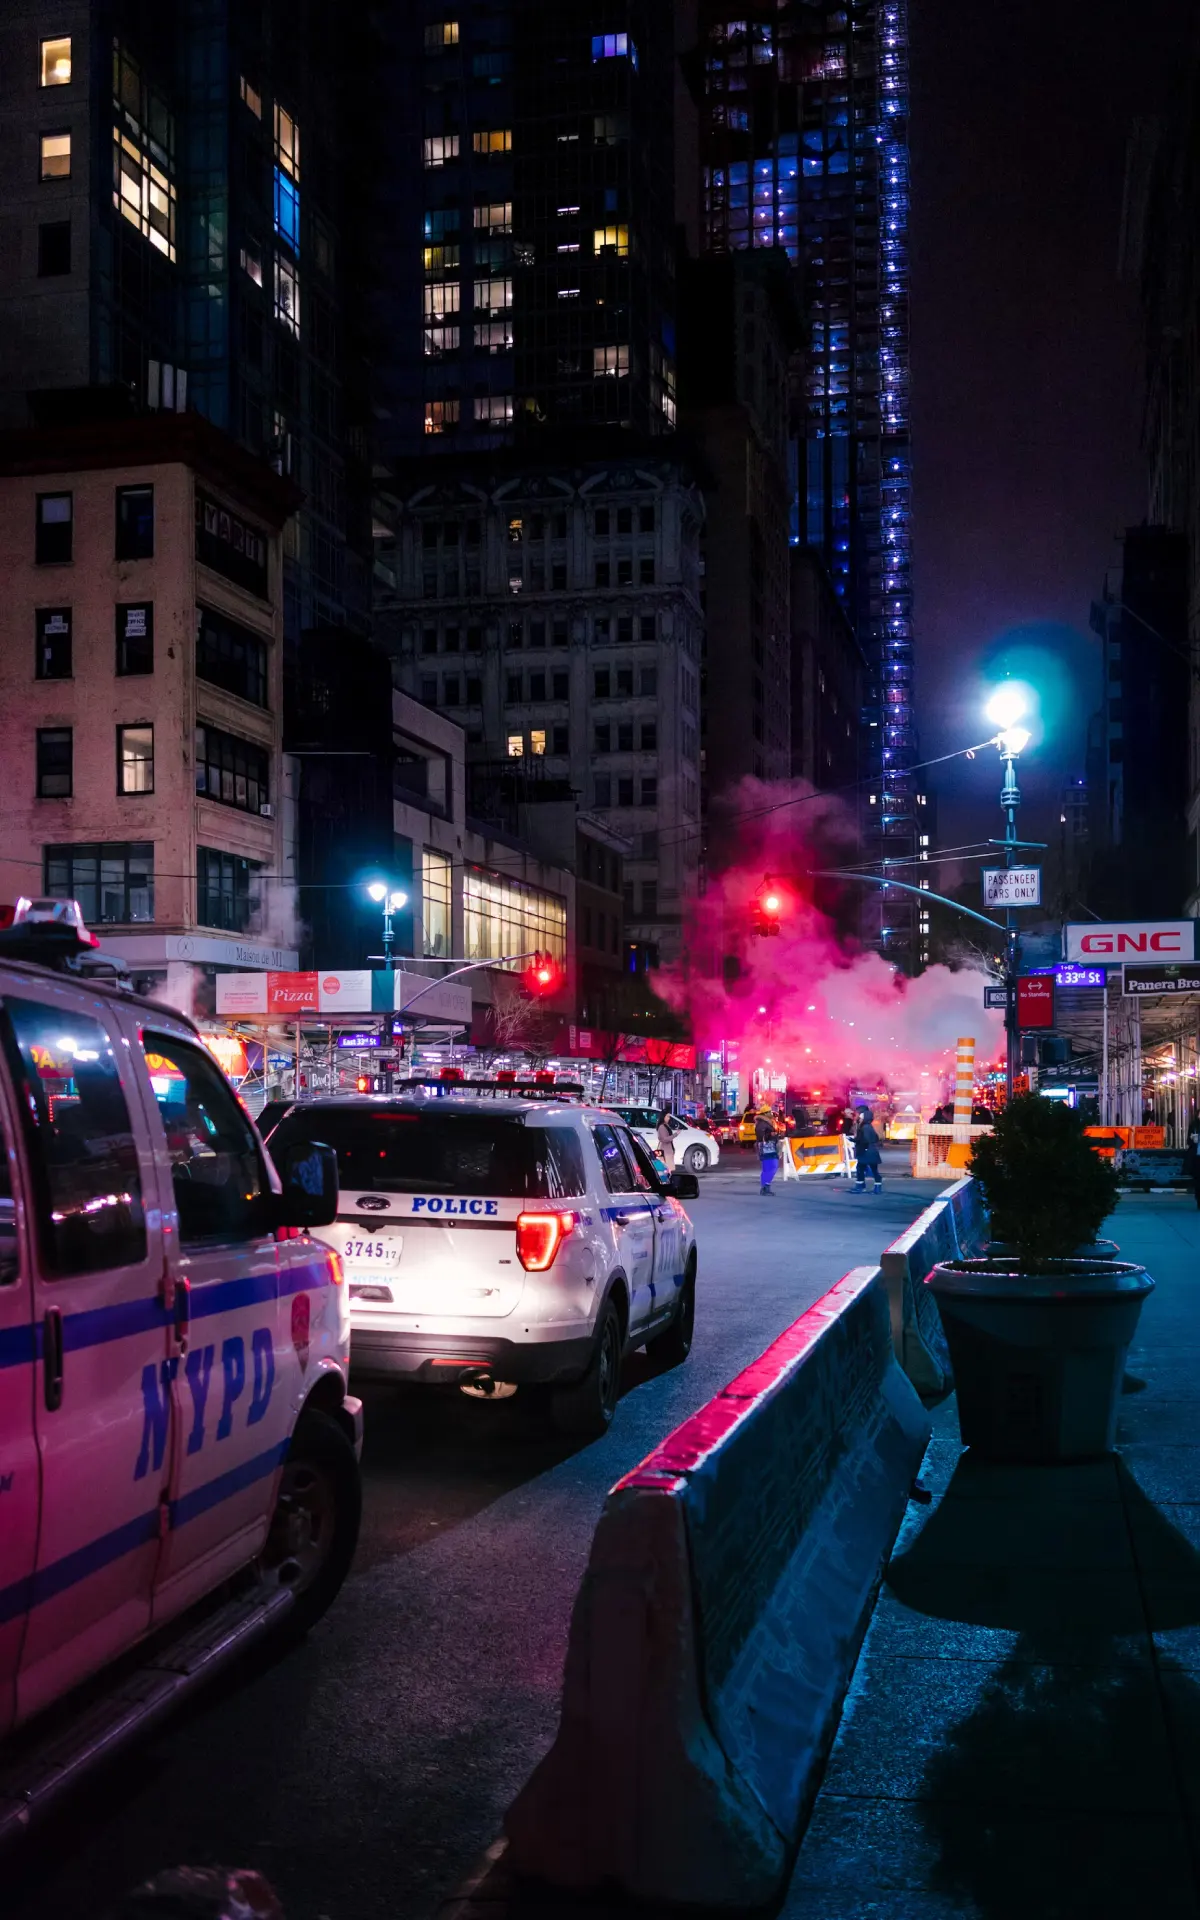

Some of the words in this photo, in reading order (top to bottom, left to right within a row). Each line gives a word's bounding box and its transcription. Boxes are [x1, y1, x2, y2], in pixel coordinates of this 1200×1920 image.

[988, 874, 1036, 885] PASSENGER
[988, 888, 1010, 899] CARS
[1014, 887, 1036, 898] ONLY
[1081, 932, 1181, 954] GNC
[236, 946, 260, 963] Maison
[1064, 971, 1086, 984] 33rd
[1088, 973, 1101, 984] St
[1128, 980, 1176, 991] Panera
[273, 989, 314, 1002] Pizza
[369, 1037, 377, 1045] St
[412, 1197, 498, 1215] POLICE
[345, 1241, 384, 1258] 3745
[386, 1250, 397, 1259] 17
[134, 1327, 276, 1482] NYPD
